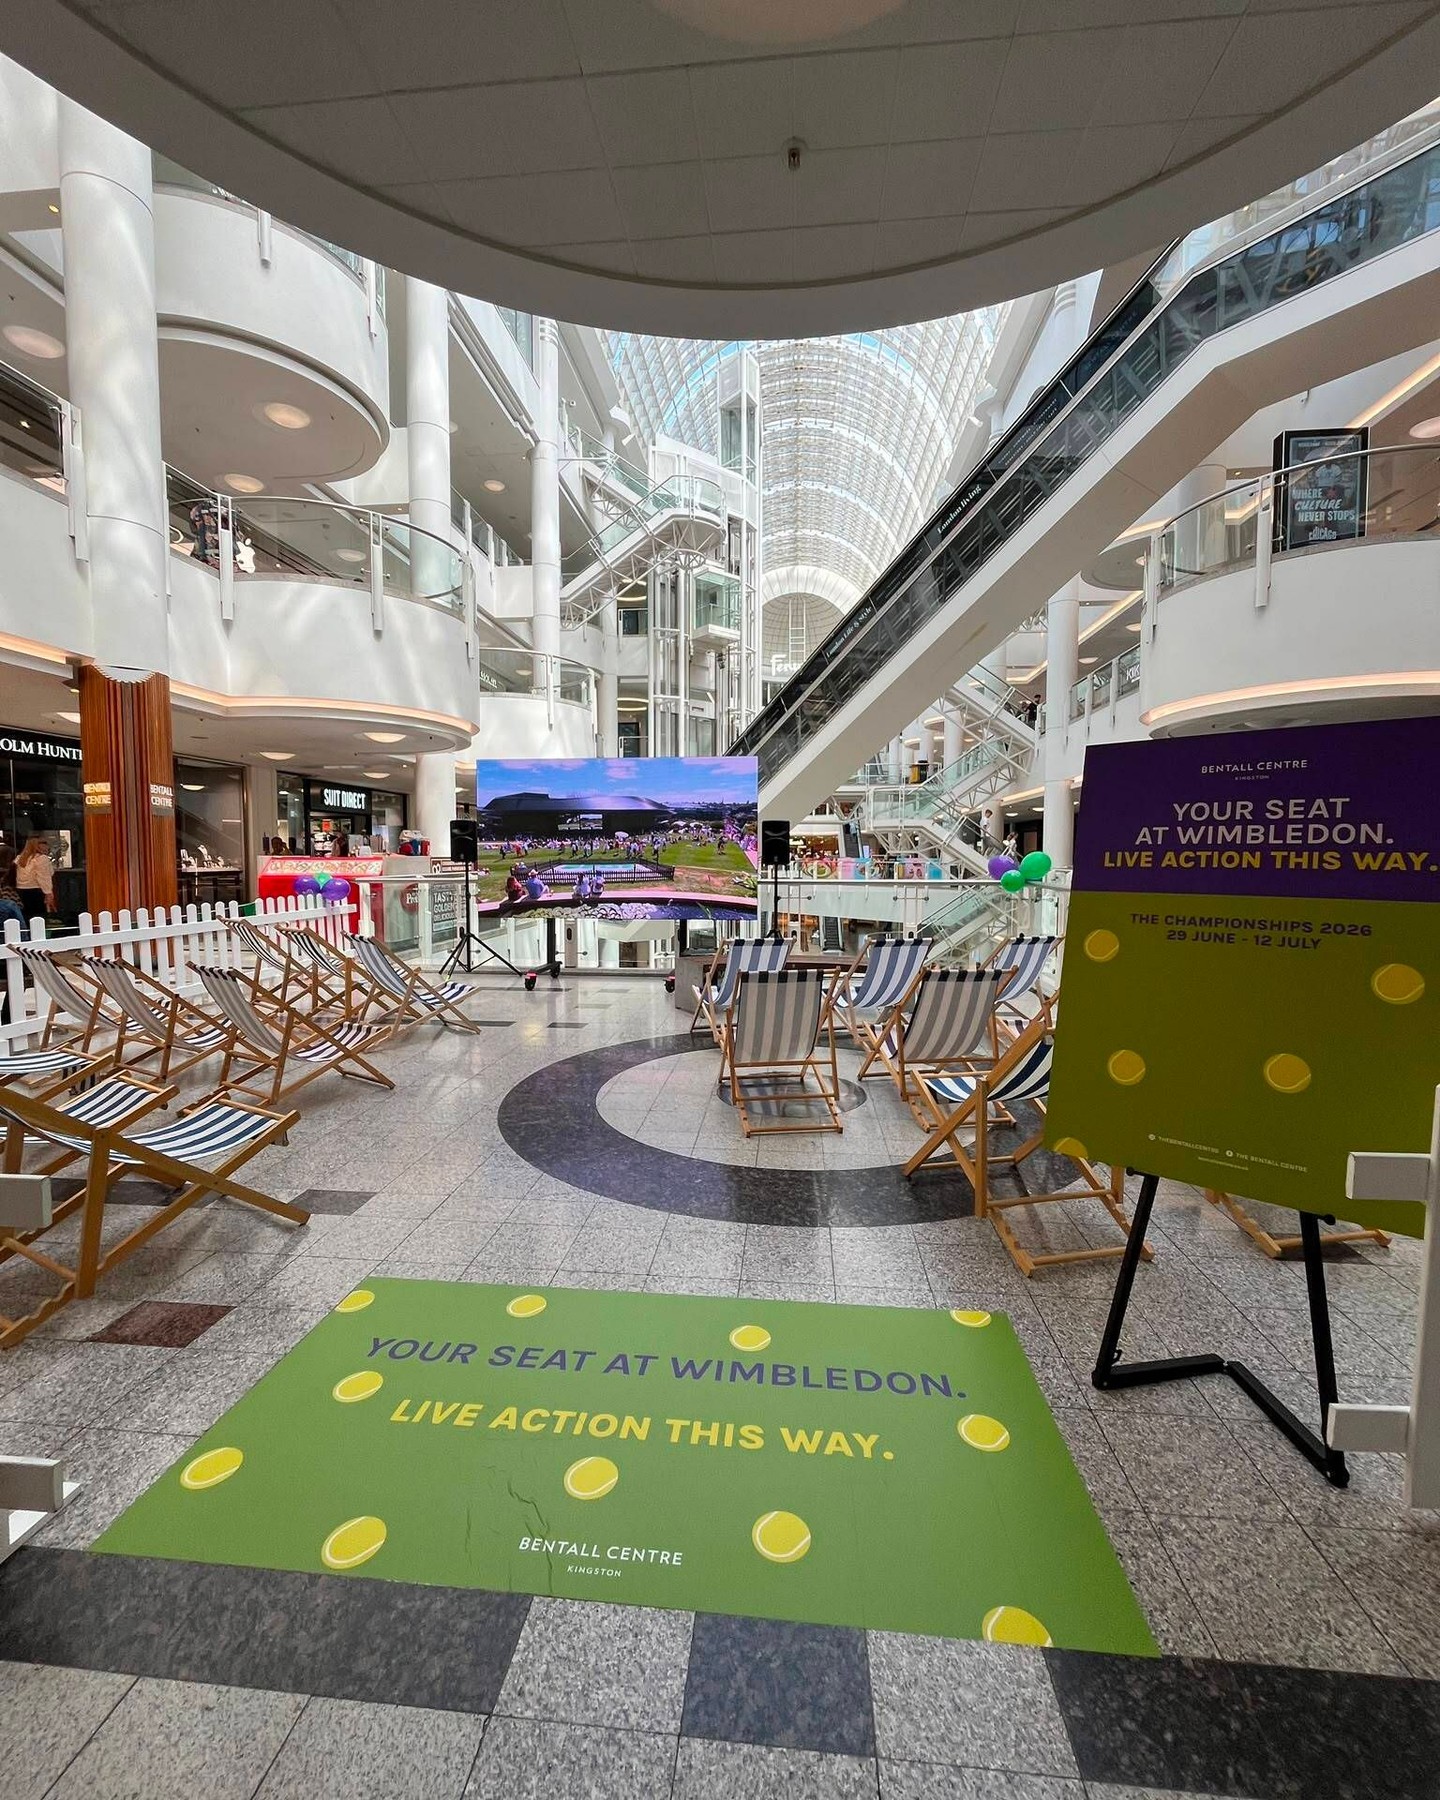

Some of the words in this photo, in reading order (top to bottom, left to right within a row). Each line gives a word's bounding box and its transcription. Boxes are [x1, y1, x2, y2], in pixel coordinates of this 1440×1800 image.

[1292, 487, 1322, 499] WHERE
[1294, 499, 1342, 511] CULTURE
[1298, 510, 1325, 522] NEVER
[1327, 509, 1356, 521] STOPS
[937, 506, 962, 534] London
[1308, 526, 1337, 540] CHICAGO
[0, 738, 35, 755] OLM
[1201, 763, 1254, 774] BENTALL
[1256, 759, 1308, 771] CENTRE
[85, 794, 112, 805] CENTRE
[323, 788, 341, 807] SUIT
[341, 790, 366, 810] DIRECT
[1173, 800, 1253, 821] YOUR
[1264, 797, 1350, 820] SEAT
[1135, 826, 1169, 845] AT
[1176, 823, 1394, 845] WIMBLEDON.
[1103, 850, 1152, 868] LIVE
[1161, 850, 1261, 869] ACTION
[1270, 851, 1342, 870] THIS
[1353, 851, 1439, 872] WAY.
[1130, 913, 1159, 926] THE
[1164, 914, 1313, 934] CHAMPIONSHIPS
[1320, 922, 1372, 937] 2026
[1166, 930, 1188, 941] 29
[1192, 932, 1236, 944] JUNE
[1254, 934, 1273, 946] 12
[1277, 935, 1321, 950] JULY
[367, 1338, 478, 1364] YOUR
[488, 1346, 597, 1372] SEAT
[602, 1354, 659, 1376] AT
[671, 1357, 967, 1399] WIMBLEDON.
[390, 1400, 484, 1427] LIVE
[488, 1407, 651, 1441] ACTION
[665, 1418, 766, 1450] THIS
[780, 1427, 894, 1460] WAY.
[518, 1536, 600, 1558] BENTALL
[606, 1546, 683, 1566] CENTRE
[566, 1565, 622, 1577] KINGSTON
